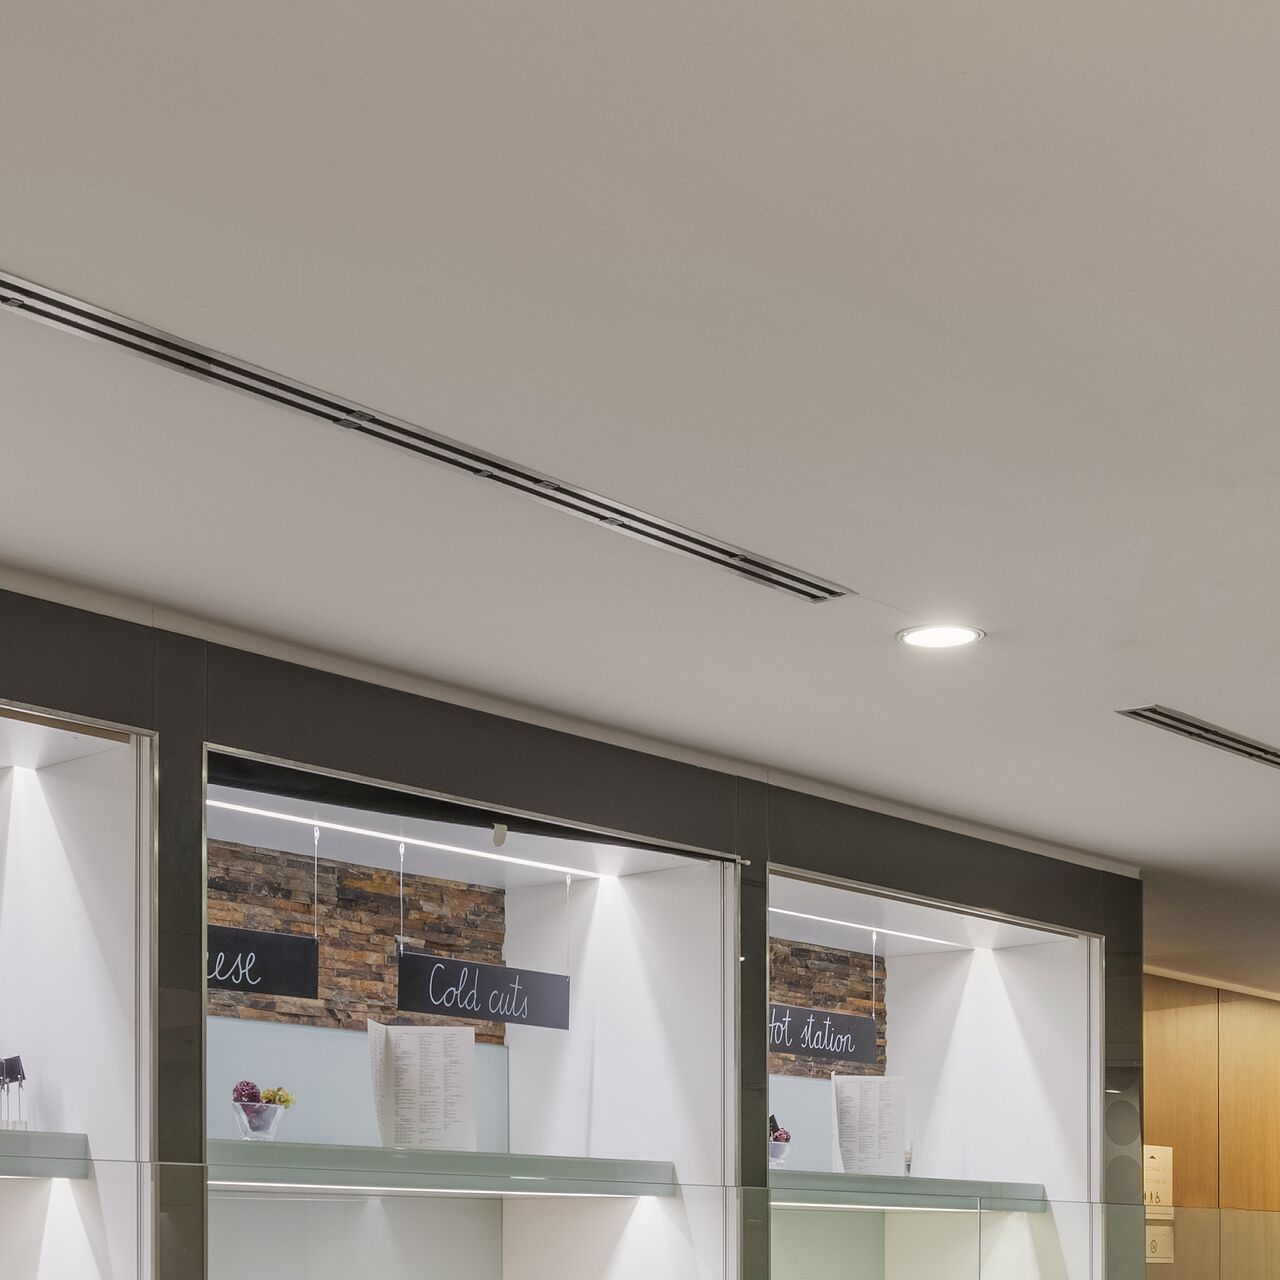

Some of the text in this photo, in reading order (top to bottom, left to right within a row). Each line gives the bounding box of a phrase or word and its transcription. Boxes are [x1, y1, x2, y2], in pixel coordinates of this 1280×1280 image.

[207, 950, 262, 986] ese
[428, 962, 530, 1019] Cold cuts
[800, 1013, 856, 1053] station
